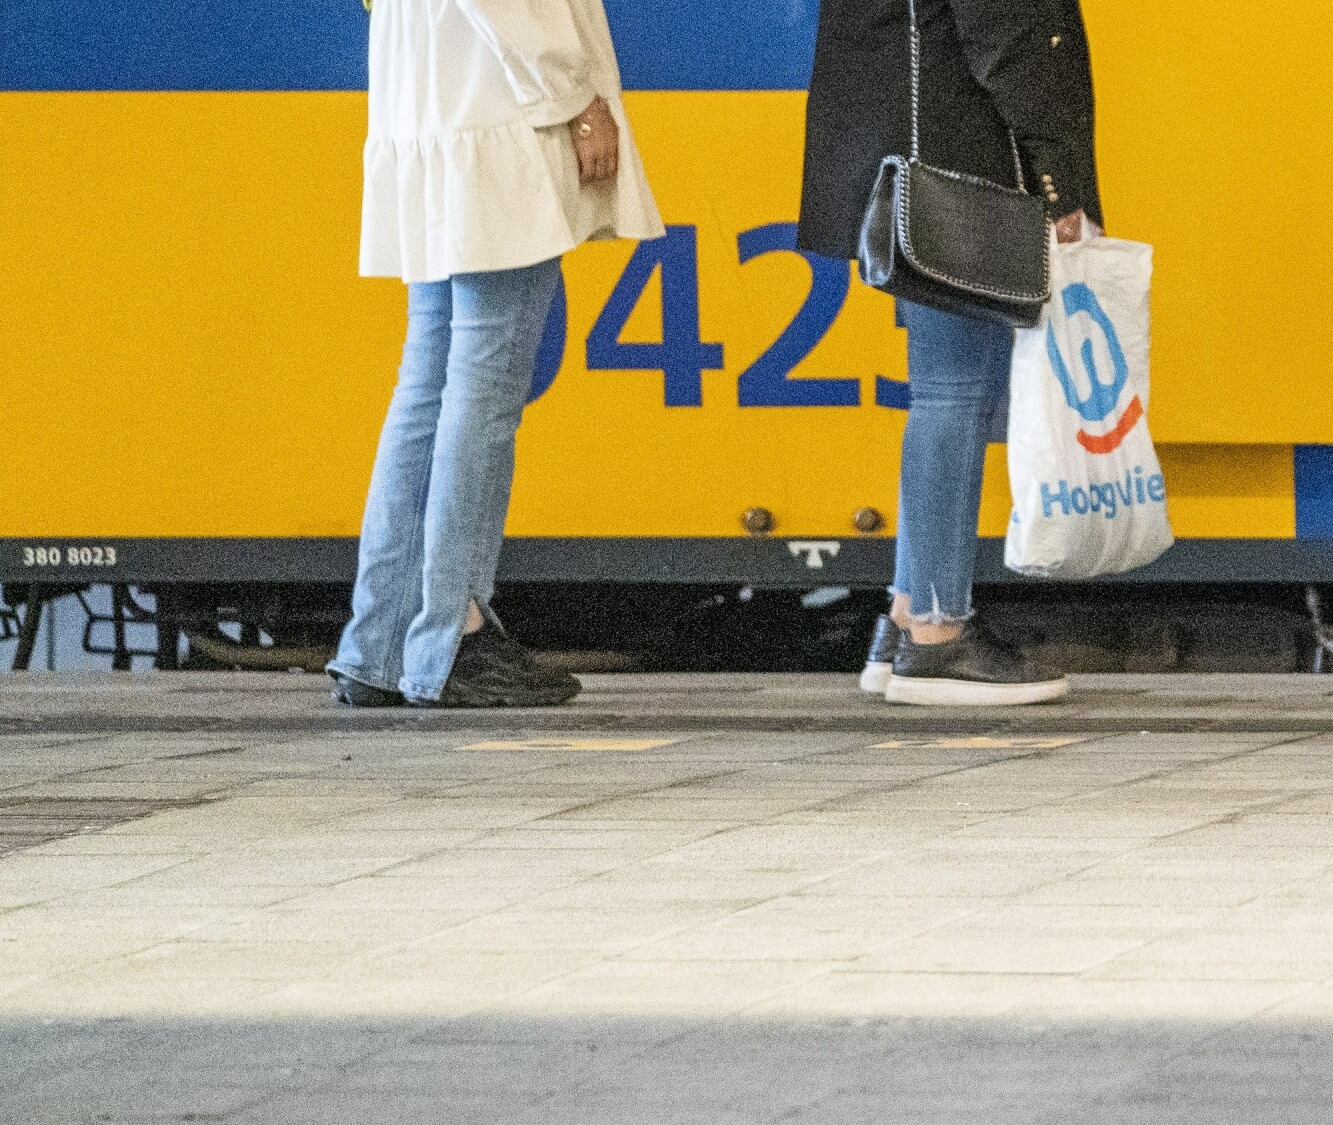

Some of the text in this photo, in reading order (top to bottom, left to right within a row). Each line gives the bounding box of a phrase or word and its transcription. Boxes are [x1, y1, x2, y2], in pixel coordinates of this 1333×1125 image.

[521, 221, 912, 411] 42
[23, 546, 118, 567] 380 8023
